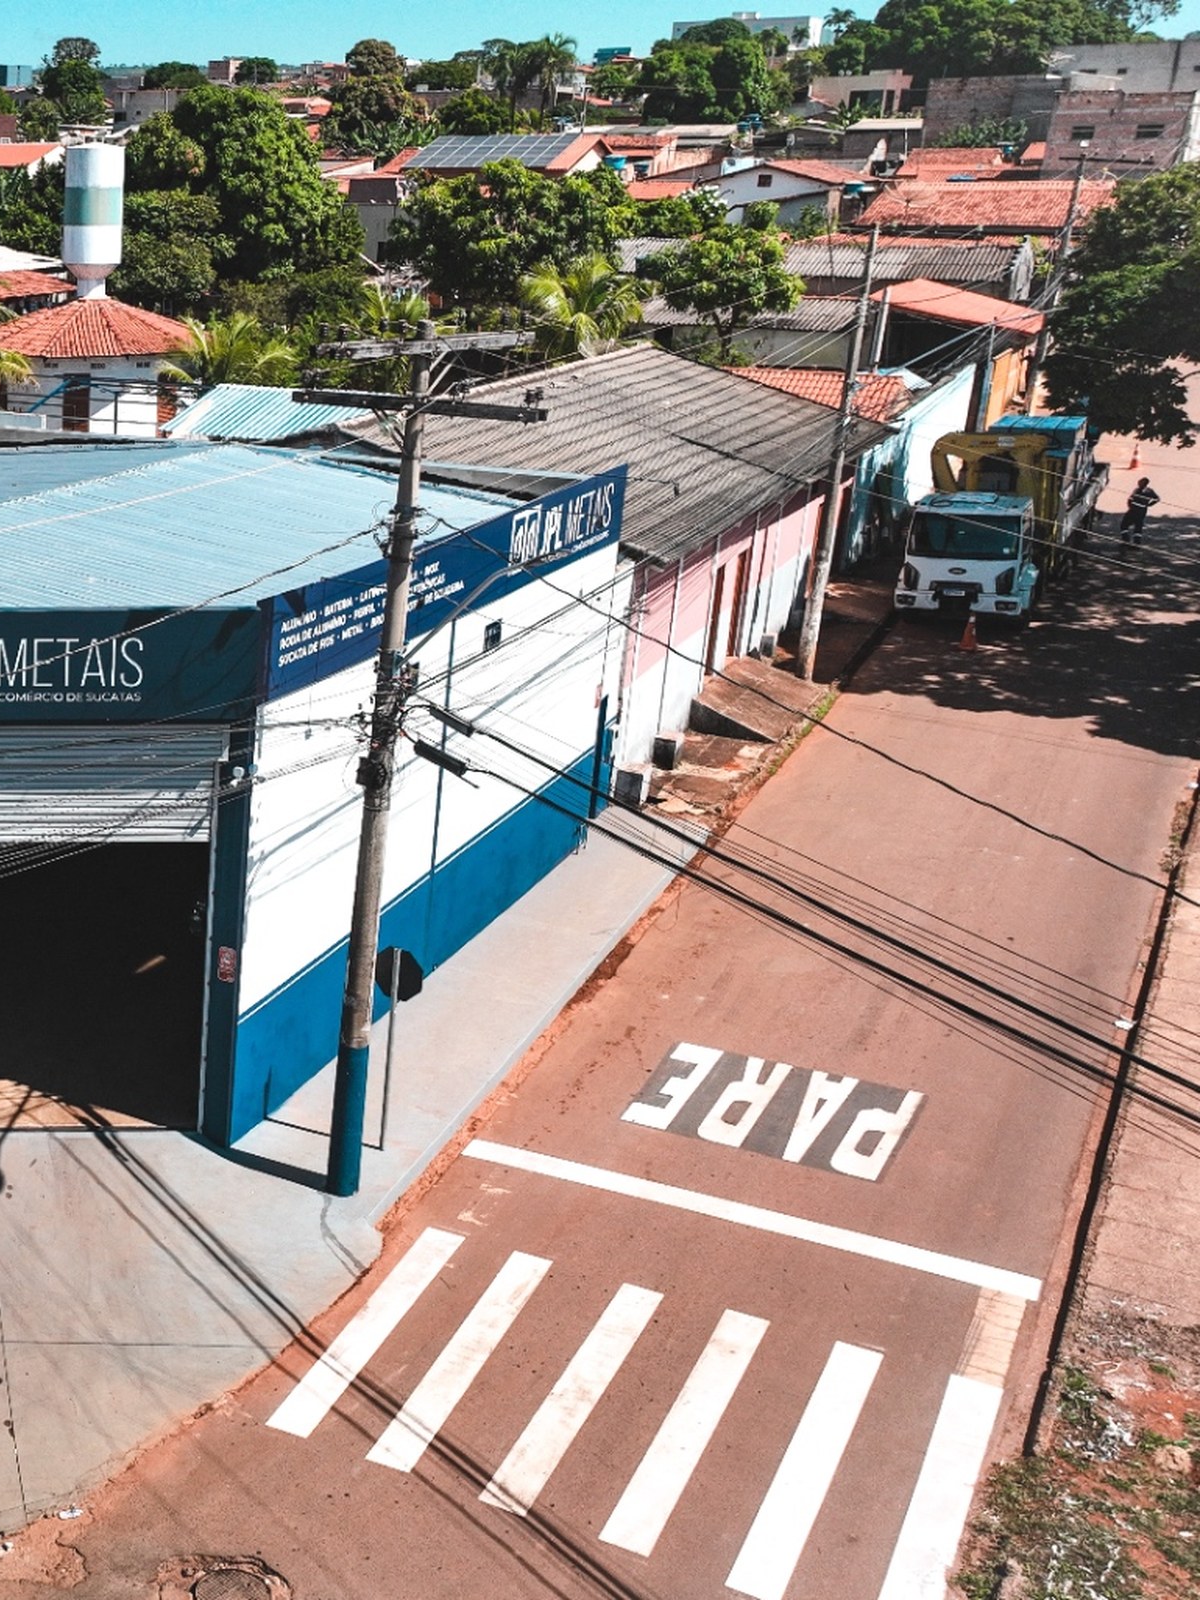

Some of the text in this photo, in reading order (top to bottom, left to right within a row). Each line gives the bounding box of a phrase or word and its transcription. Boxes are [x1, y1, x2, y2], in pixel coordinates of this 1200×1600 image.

[539, 503, 564, 556] JPL
[564, 483, 615, 546] METAIS
[65, 690, 83, 703] DE
[84, 690, 142, 703] SUCATAS
[620, 1041, 927, 1181] PARE
